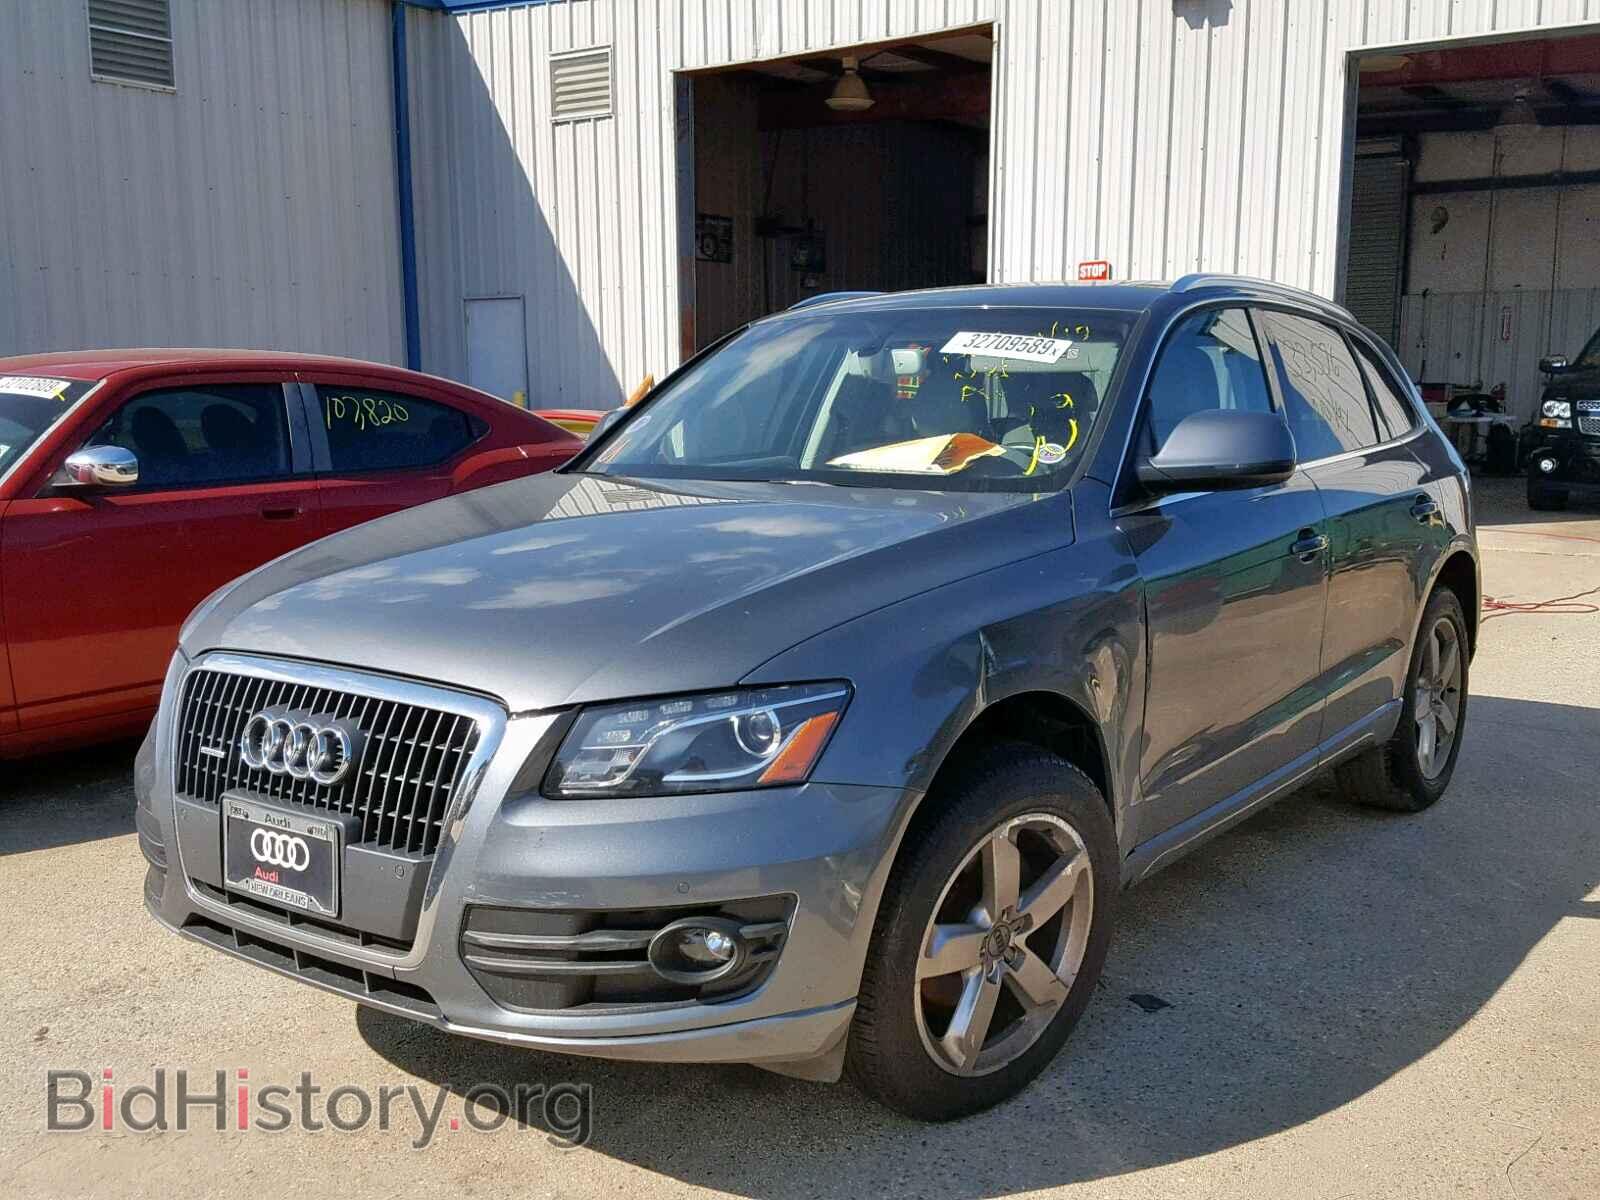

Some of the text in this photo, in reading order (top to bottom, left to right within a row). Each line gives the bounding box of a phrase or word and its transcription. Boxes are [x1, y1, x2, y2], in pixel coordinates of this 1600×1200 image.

[1080, 263, 1106, 278] STOP
[963, 332, 1055, 355] 32709589
[325, 395, 409, 430] 107,820
[264, 813, 290, 828] Audi
[254, 865, 279, 882] Audi
